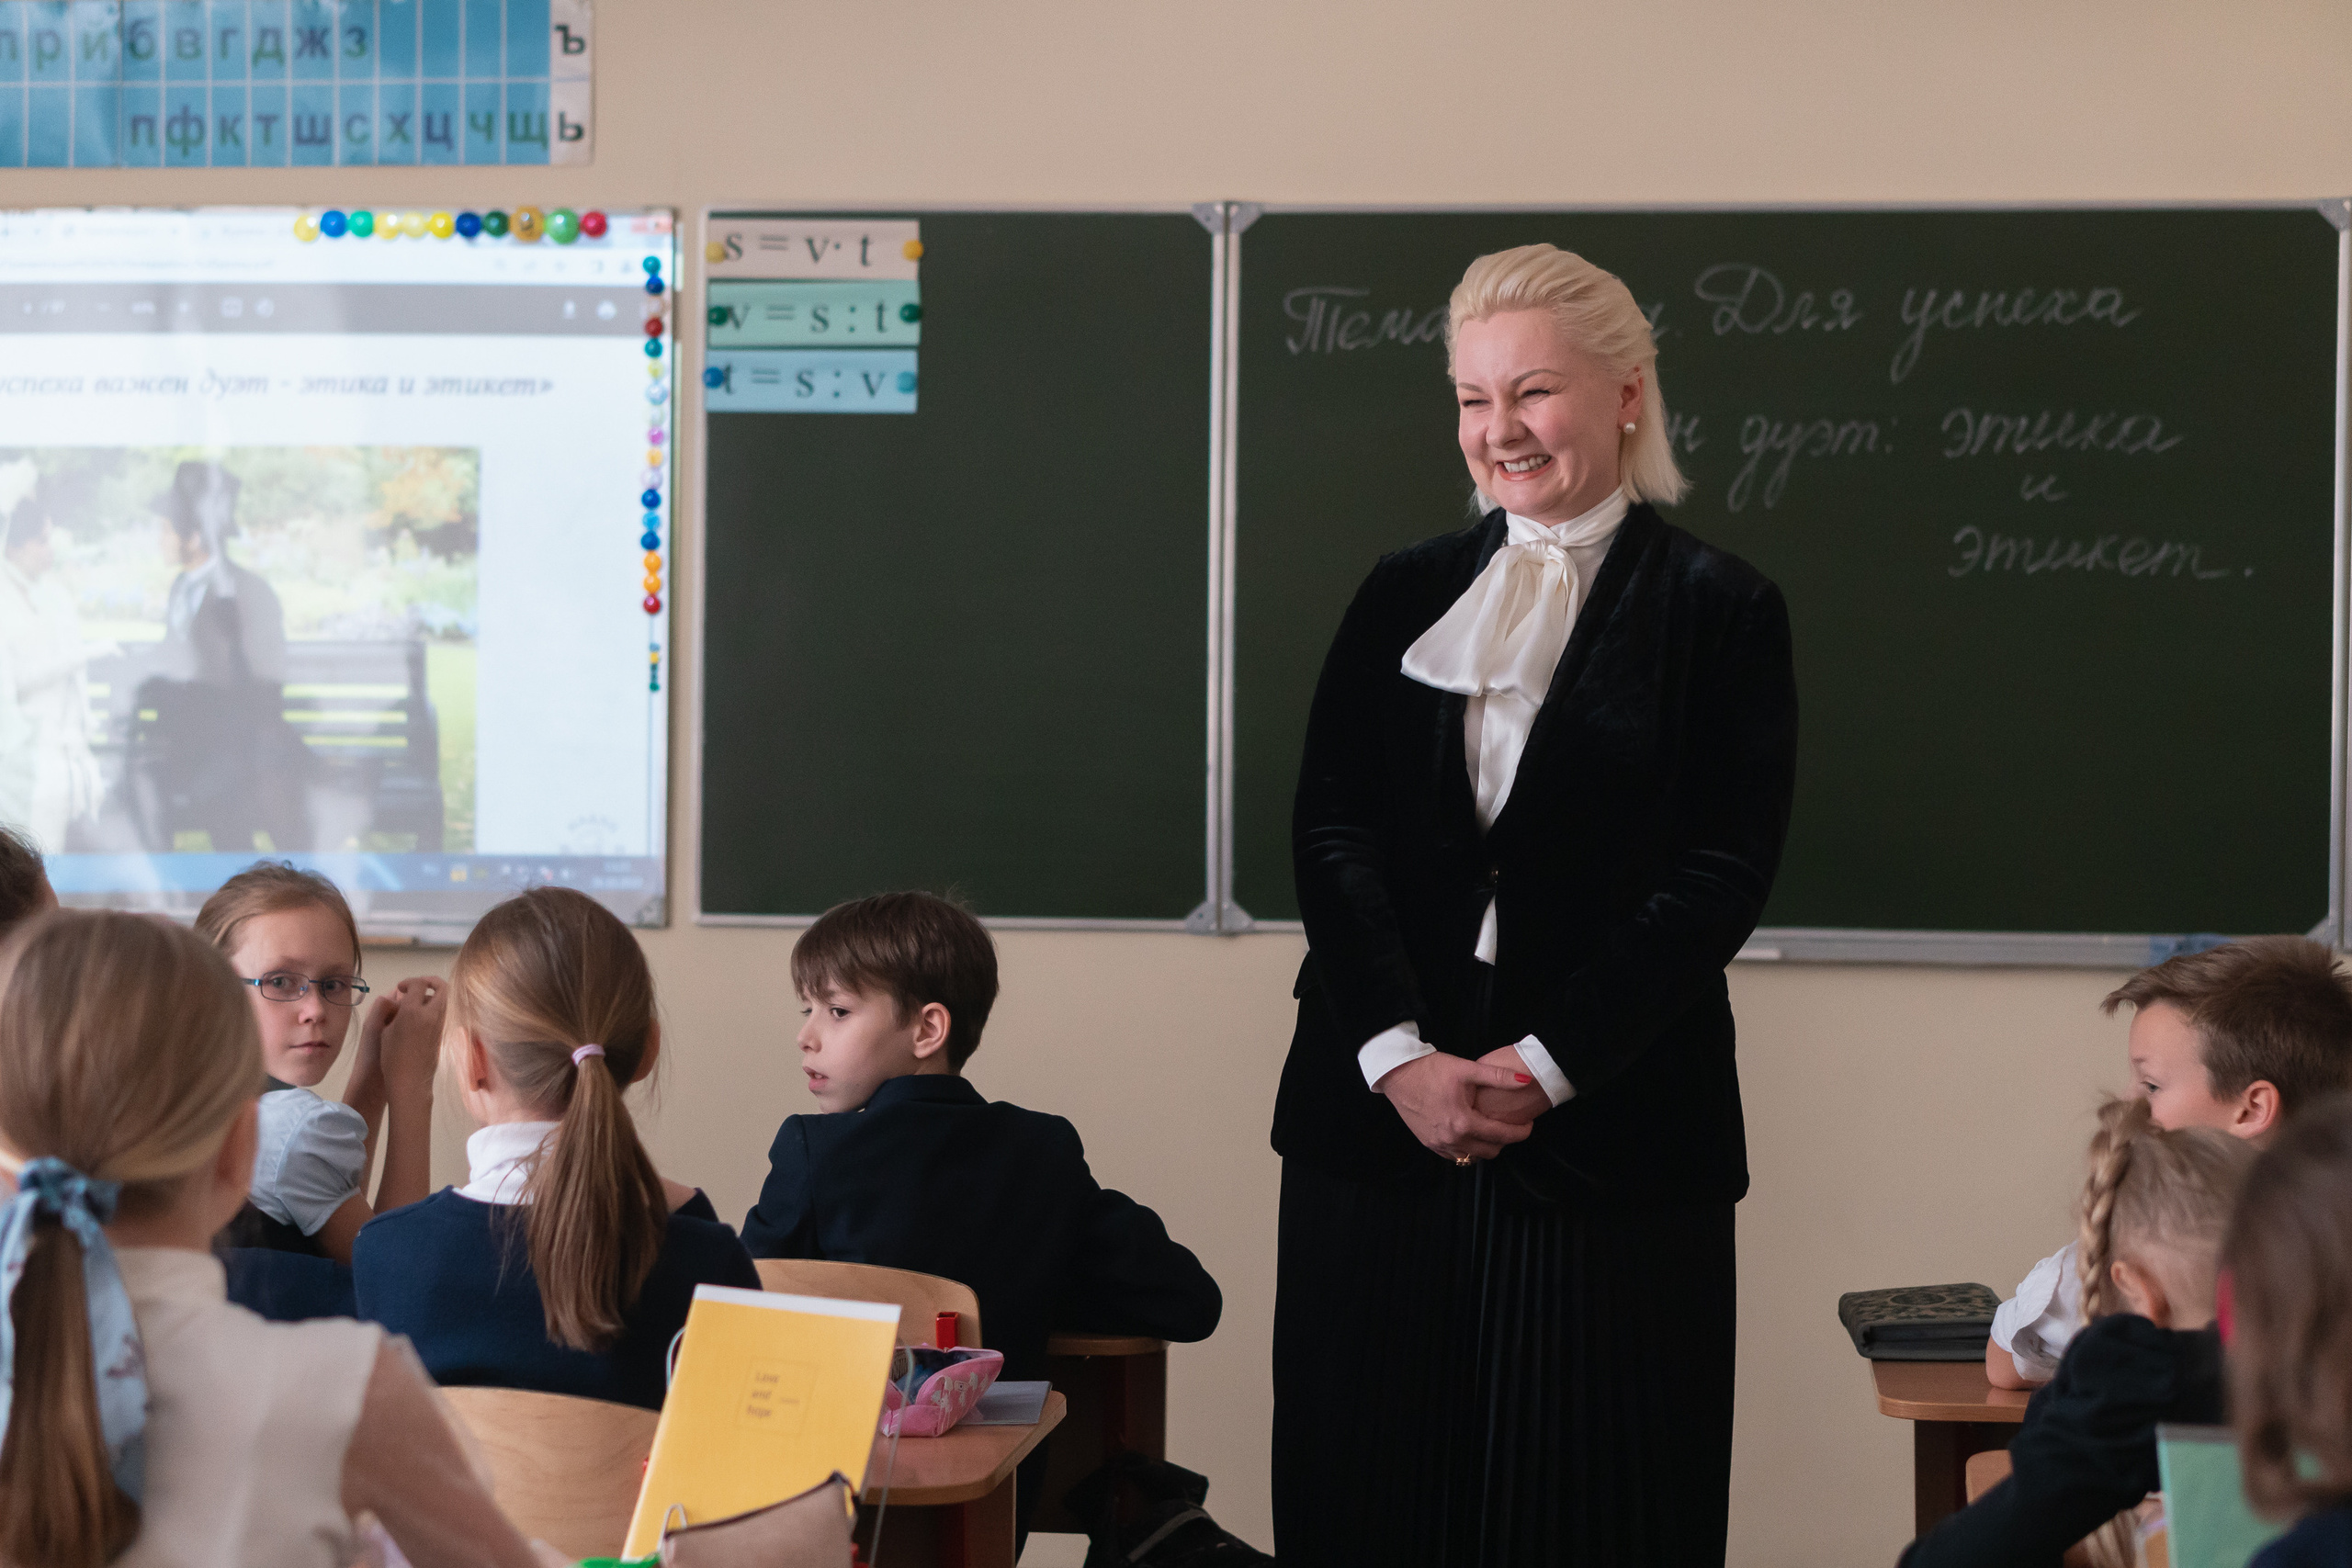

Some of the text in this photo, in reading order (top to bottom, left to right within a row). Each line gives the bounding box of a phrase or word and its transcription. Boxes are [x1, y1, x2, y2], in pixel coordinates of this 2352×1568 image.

[129, 18, 155, 61] б
[175, 27, 202, 60] в
[220, 27, 240, 60] г
[252, 26, 285, 67] д
[295, 27, 330, 60] ж
[130, 114, 156, 148] п
[165, 106, 205, 156] ф
[219, 114, 241, 147] к
[255, 114, 279, 146] т
[294, 114, 332, 146] ш
[345, 114, 368, 144] с
[388, 112, 411, 143] х
[425, 112, 454, 151] ц
[469, 111, 493, 143] ч
[509, 111, 548, 151] щ
[724, 232, 743, 262] s
[726, 303, 751, 332] v
[810, 304, 830, 333] s
[876, 300, 888, 333] t
[1694, 262, 1862, 335] Для
[1889, 285, 2143, 384] успеха
[95, 375, 189, 395] важен
[199, 367, 269, 400] дуэт
[300, 376, 389, 396] этика
[399, 376, 416, 396] и
[795, 369, 815, 398] s
[862, 371, 886, 398] v
[2020, 472, 2070, 503] и
